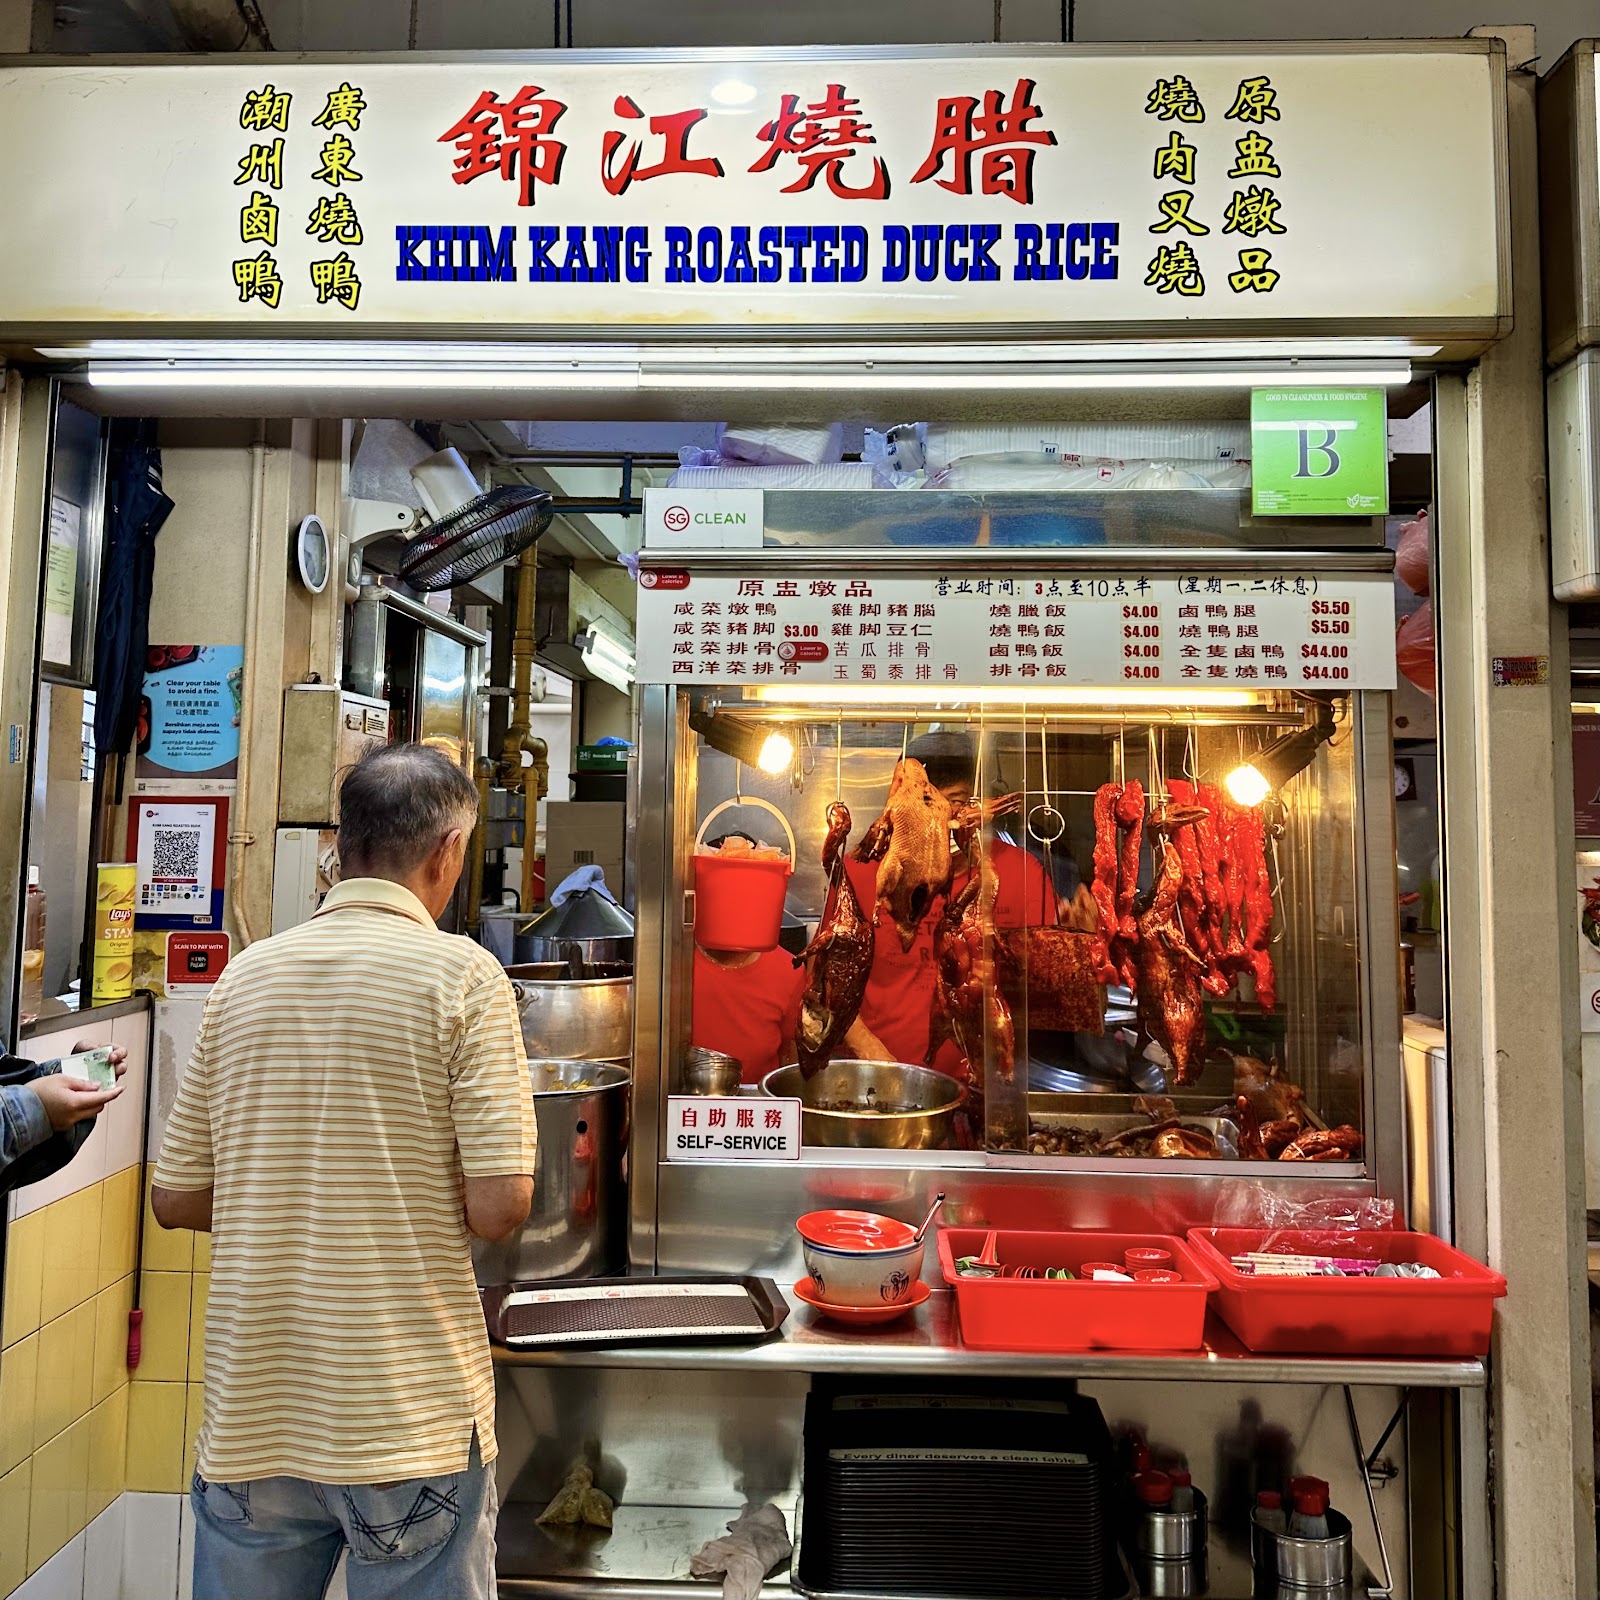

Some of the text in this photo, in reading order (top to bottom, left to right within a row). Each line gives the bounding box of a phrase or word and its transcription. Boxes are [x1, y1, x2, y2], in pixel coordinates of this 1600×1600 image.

[1144, 75, 1210, 297] 燒肉叉燒
[1222, 76, 1287, 293] 原盅燉品
[306, 82, 367, 311] 廣東燒鴨
[396, 222, 1119, 283] KHIM KANG ROASTED DUCK RICE
[1265, 393, 1281, 401] GOOD
[1291, 421, 1340, 478] B
[667, 513, 746, 524] SG CLEAN
[737, 580, 872, 598] 原盅燉品
[1122, 605, 1158, 619] $4.00
[1311, 600, 1350, 615] $5.50
[784, 624, 819, 637] $3.00
[989, 623, 1159, 638] 燒鴨飯 $4.00
[1178, 619, 1350, 638] 燒鴨腿 $5.50
[672, 641, 776, 656] 咸菜排骨
[834, 641, 930, 658] 苦瓜排骨
[989, 643, 1160, 658] 鹵鴨飯 $4.00
[1301, 643, 1348, 659] $44.00
[672, 660, 802, 676] 西洋菜排骨
[990, 663, 1160, 679] 排骨飯 $4.00
[1302, 665, 1349, 680] $44.00
[110, 909, 131, 921] Lay's
[104, 928, 133, 939] STAX
[682, 1107, 782, 1128] 自助服務
[677, 1135, 786, 1150] SELF-SERVICE
[843, 1453, 881, 1461] Every
